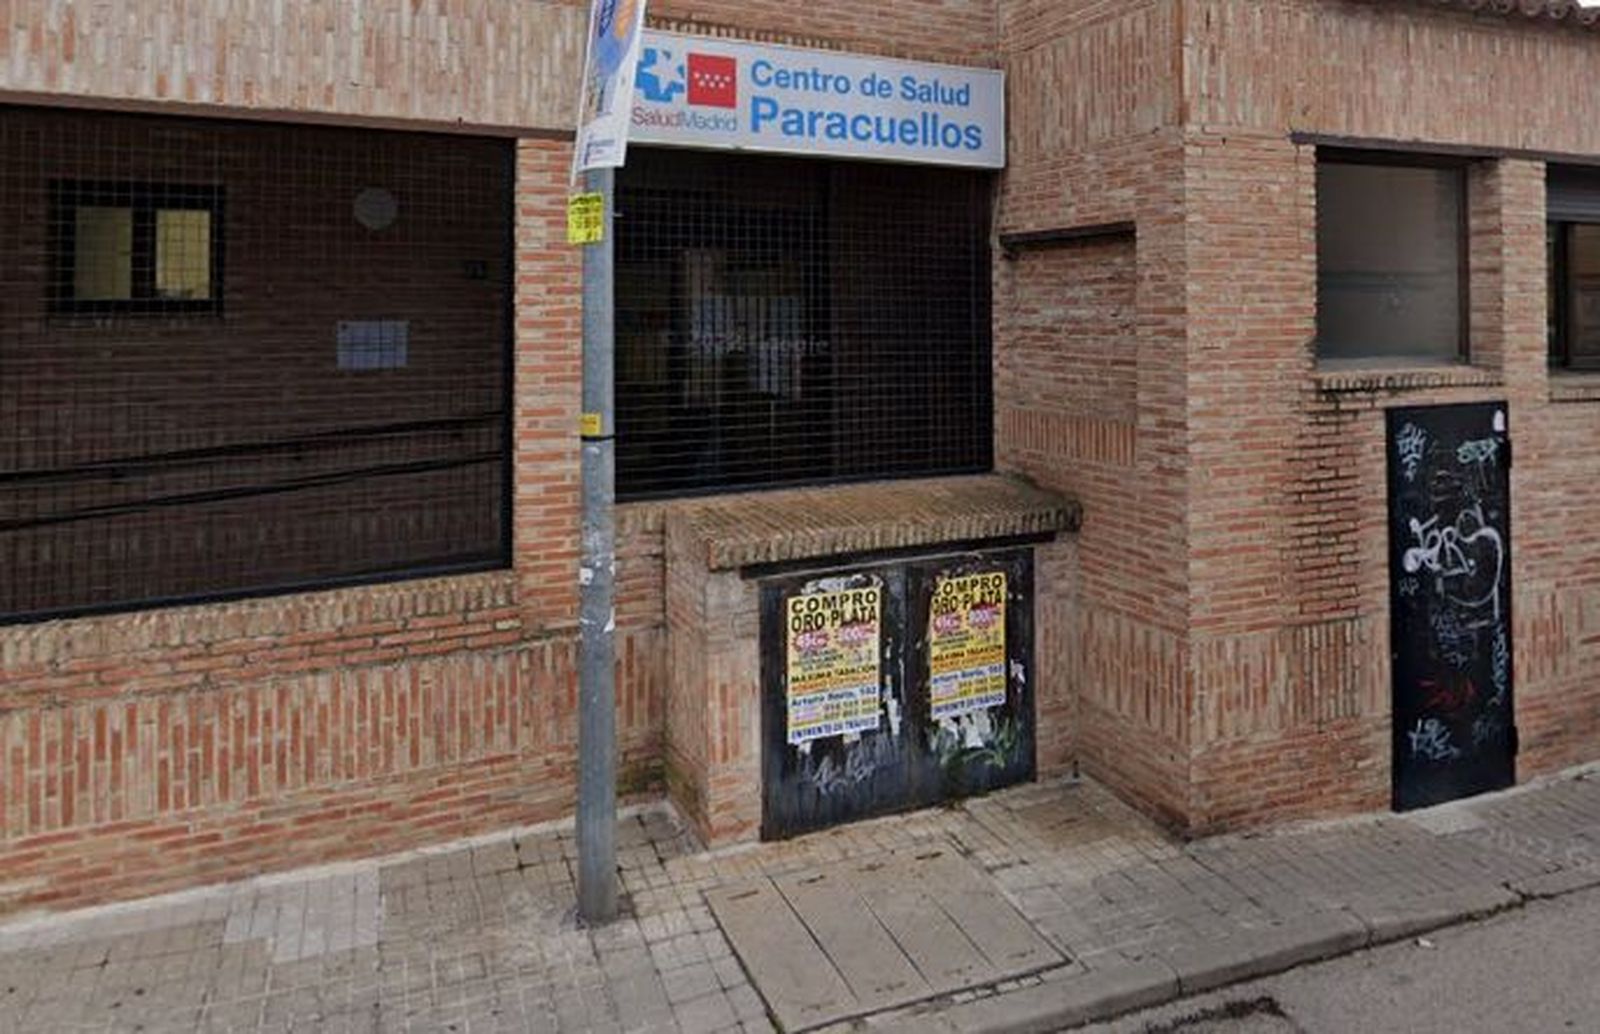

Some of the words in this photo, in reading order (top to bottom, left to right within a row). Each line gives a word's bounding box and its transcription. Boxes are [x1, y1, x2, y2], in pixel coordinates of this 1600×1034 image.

[750, 60, 851, 95] Centro
[860, 72, 892, 99] de
[900, 75, 971, 107] Salud
[750, 96, 982, 151] Paracuellos
[791, 590, 877, 613] COMPRO
